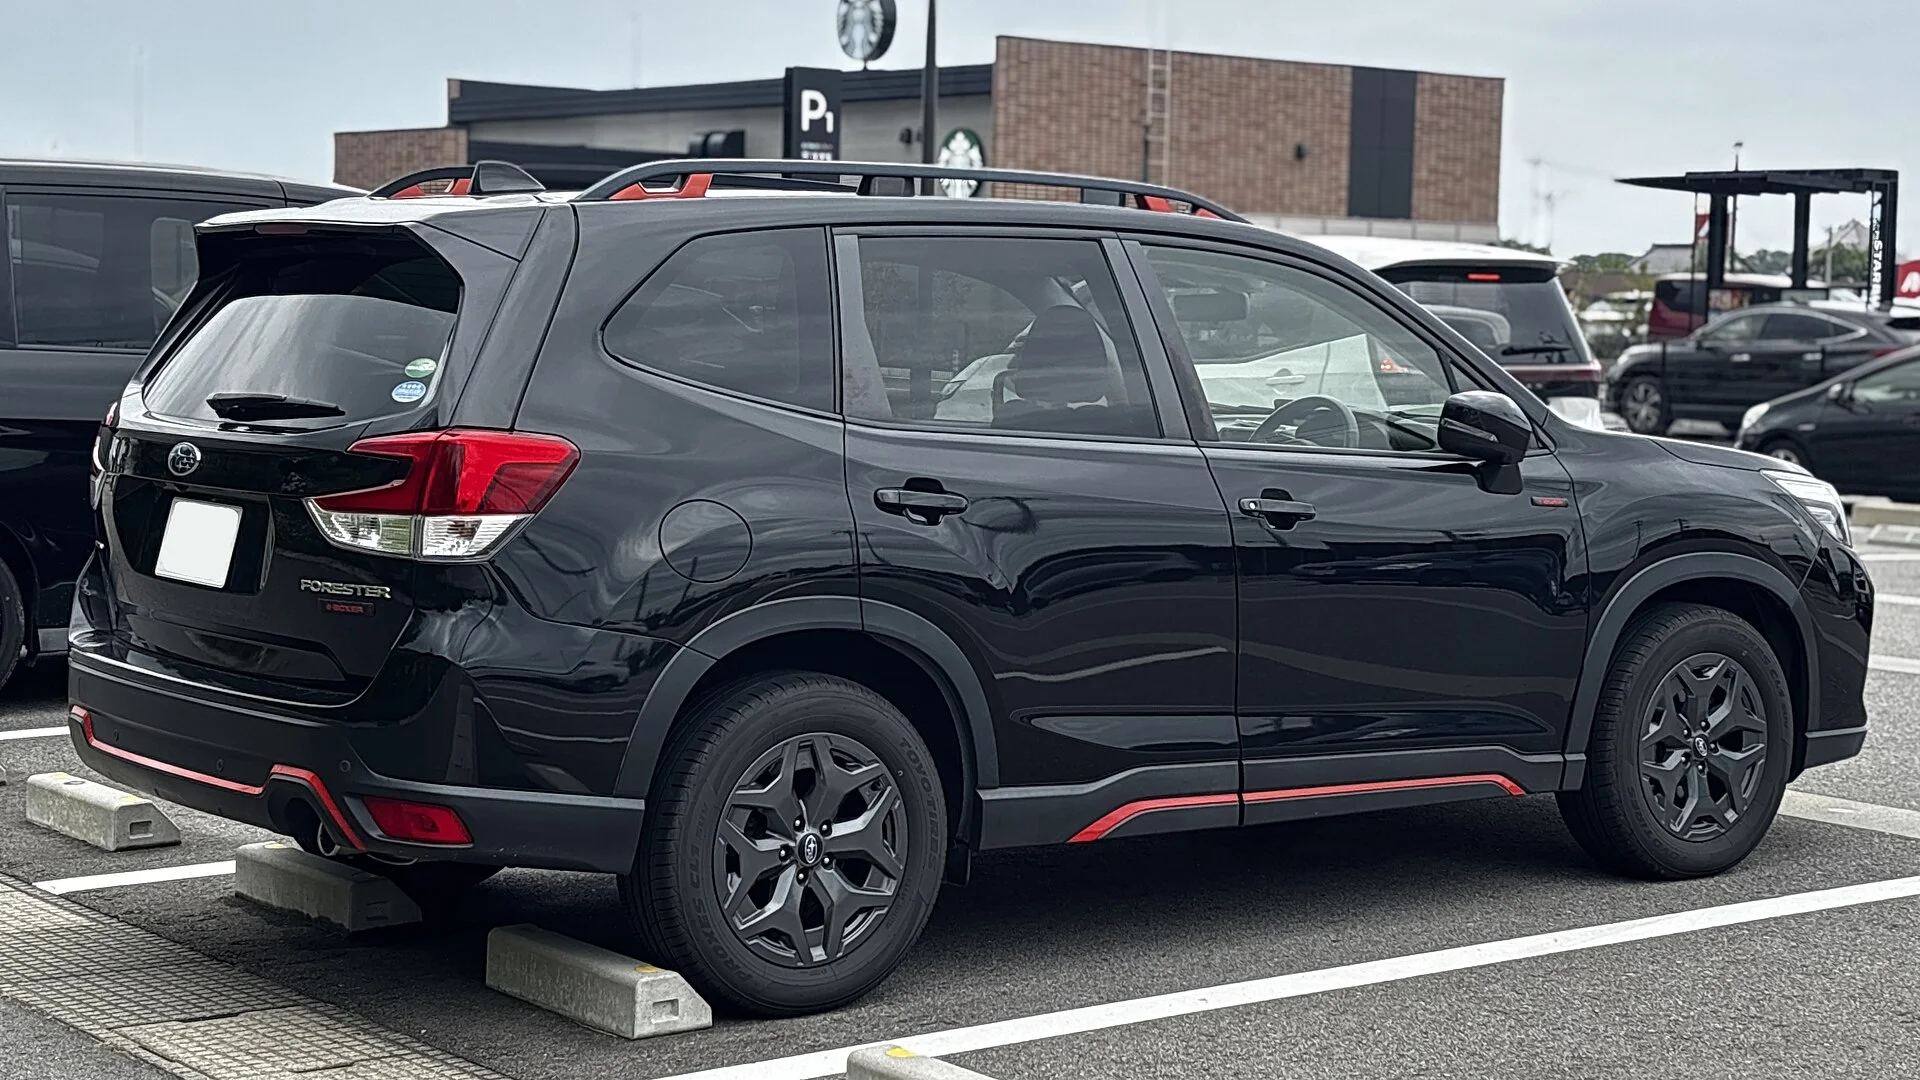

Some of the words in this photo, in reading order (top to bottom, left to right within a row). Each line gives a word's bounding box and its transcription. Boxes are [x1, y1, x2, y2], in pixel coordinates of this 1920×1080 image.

[300, 579, 391, 598] FORESTER
[900, 737, 932, 793] TOYO
[927, 798, 939, 870] TIRES
